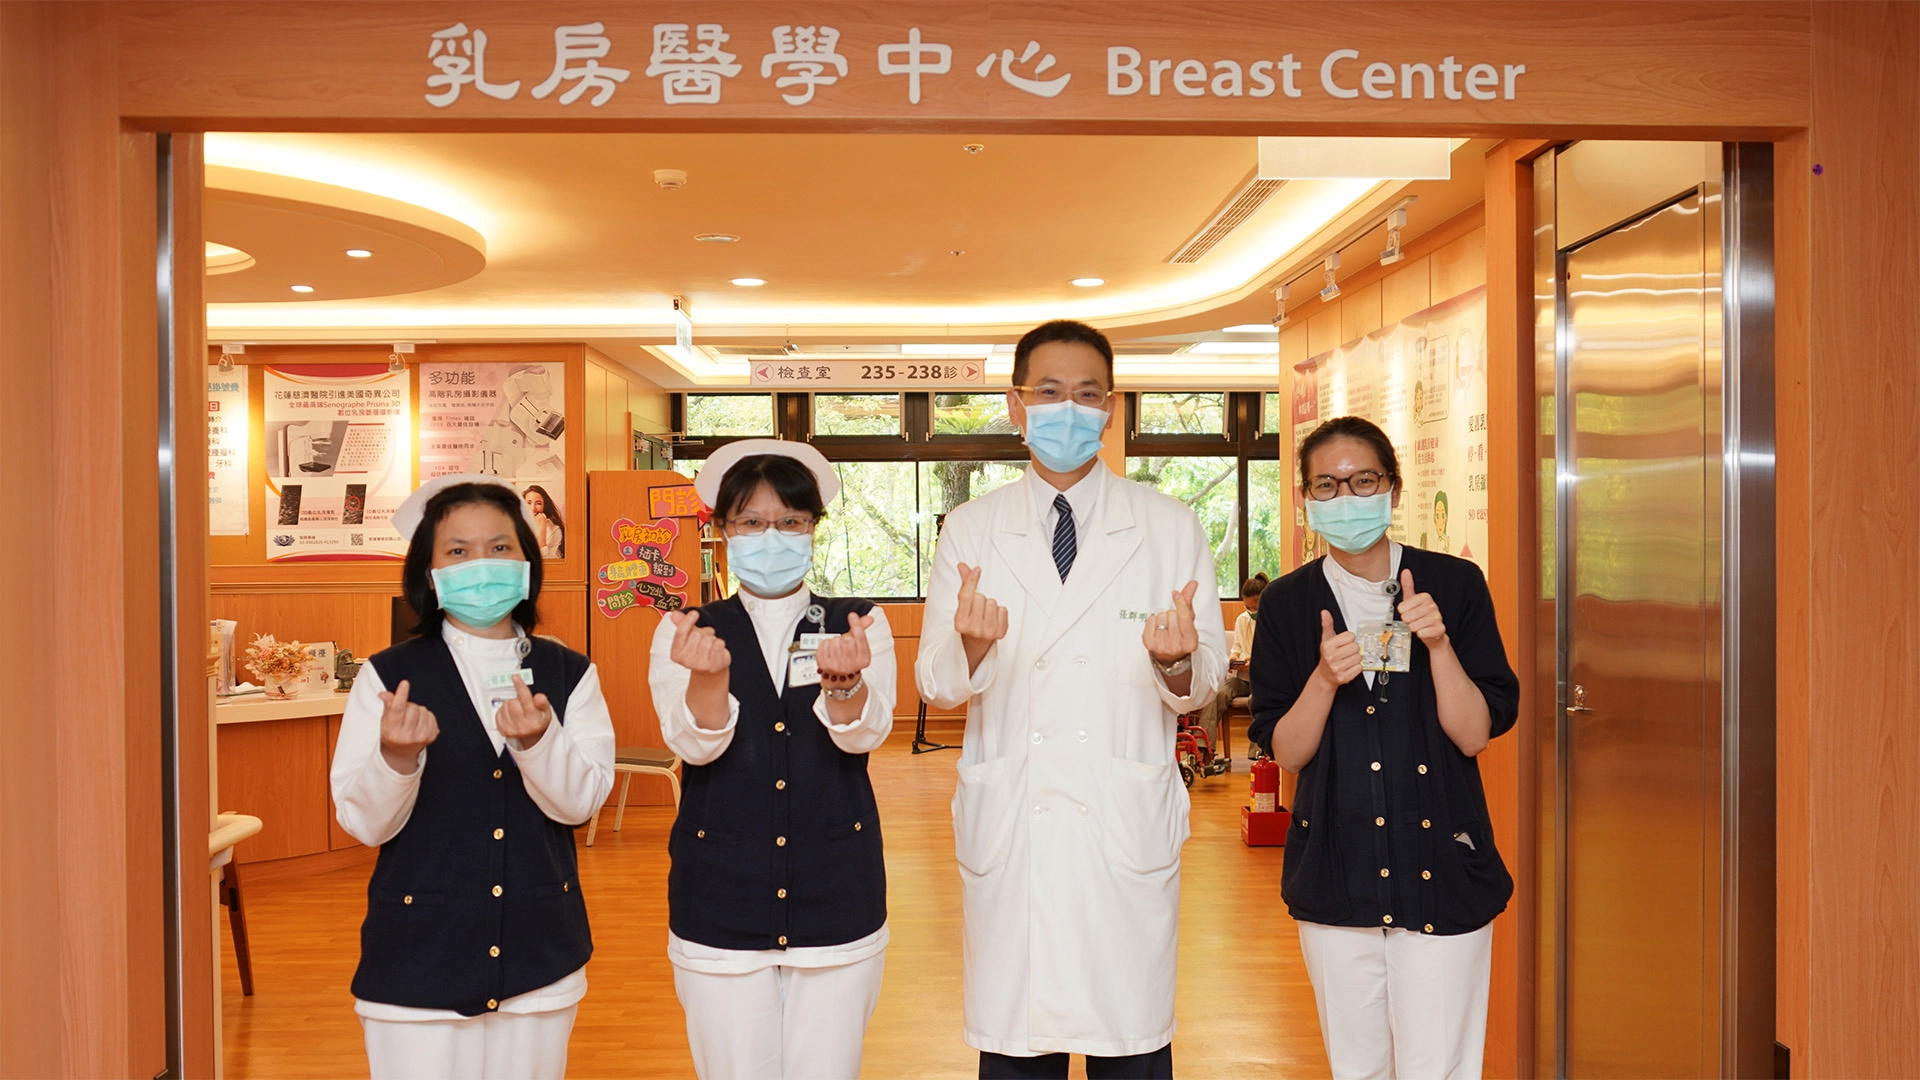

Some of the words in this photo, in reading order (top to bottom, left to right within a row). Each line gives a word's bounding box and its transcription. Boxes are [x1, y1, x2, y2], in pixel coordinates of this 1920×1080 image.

[424, 21, 1072, 108] 乳房醫學中心
[1106, 46, 1302, 98] Breast
[1320, 48, 1526, 101] Center
[428, 370, 476, 386] 多功能
[777, 365, 832, 380] 檢查室
[274, 389, 401, 400] 花蓮慈濟醫院引進美國奇異公司
[428, 389, 497, 399] 高階乳房攝影儀器
[1468, 412, 1488, 433] 愛護乳
[649, 487, 701, 517] 門診
